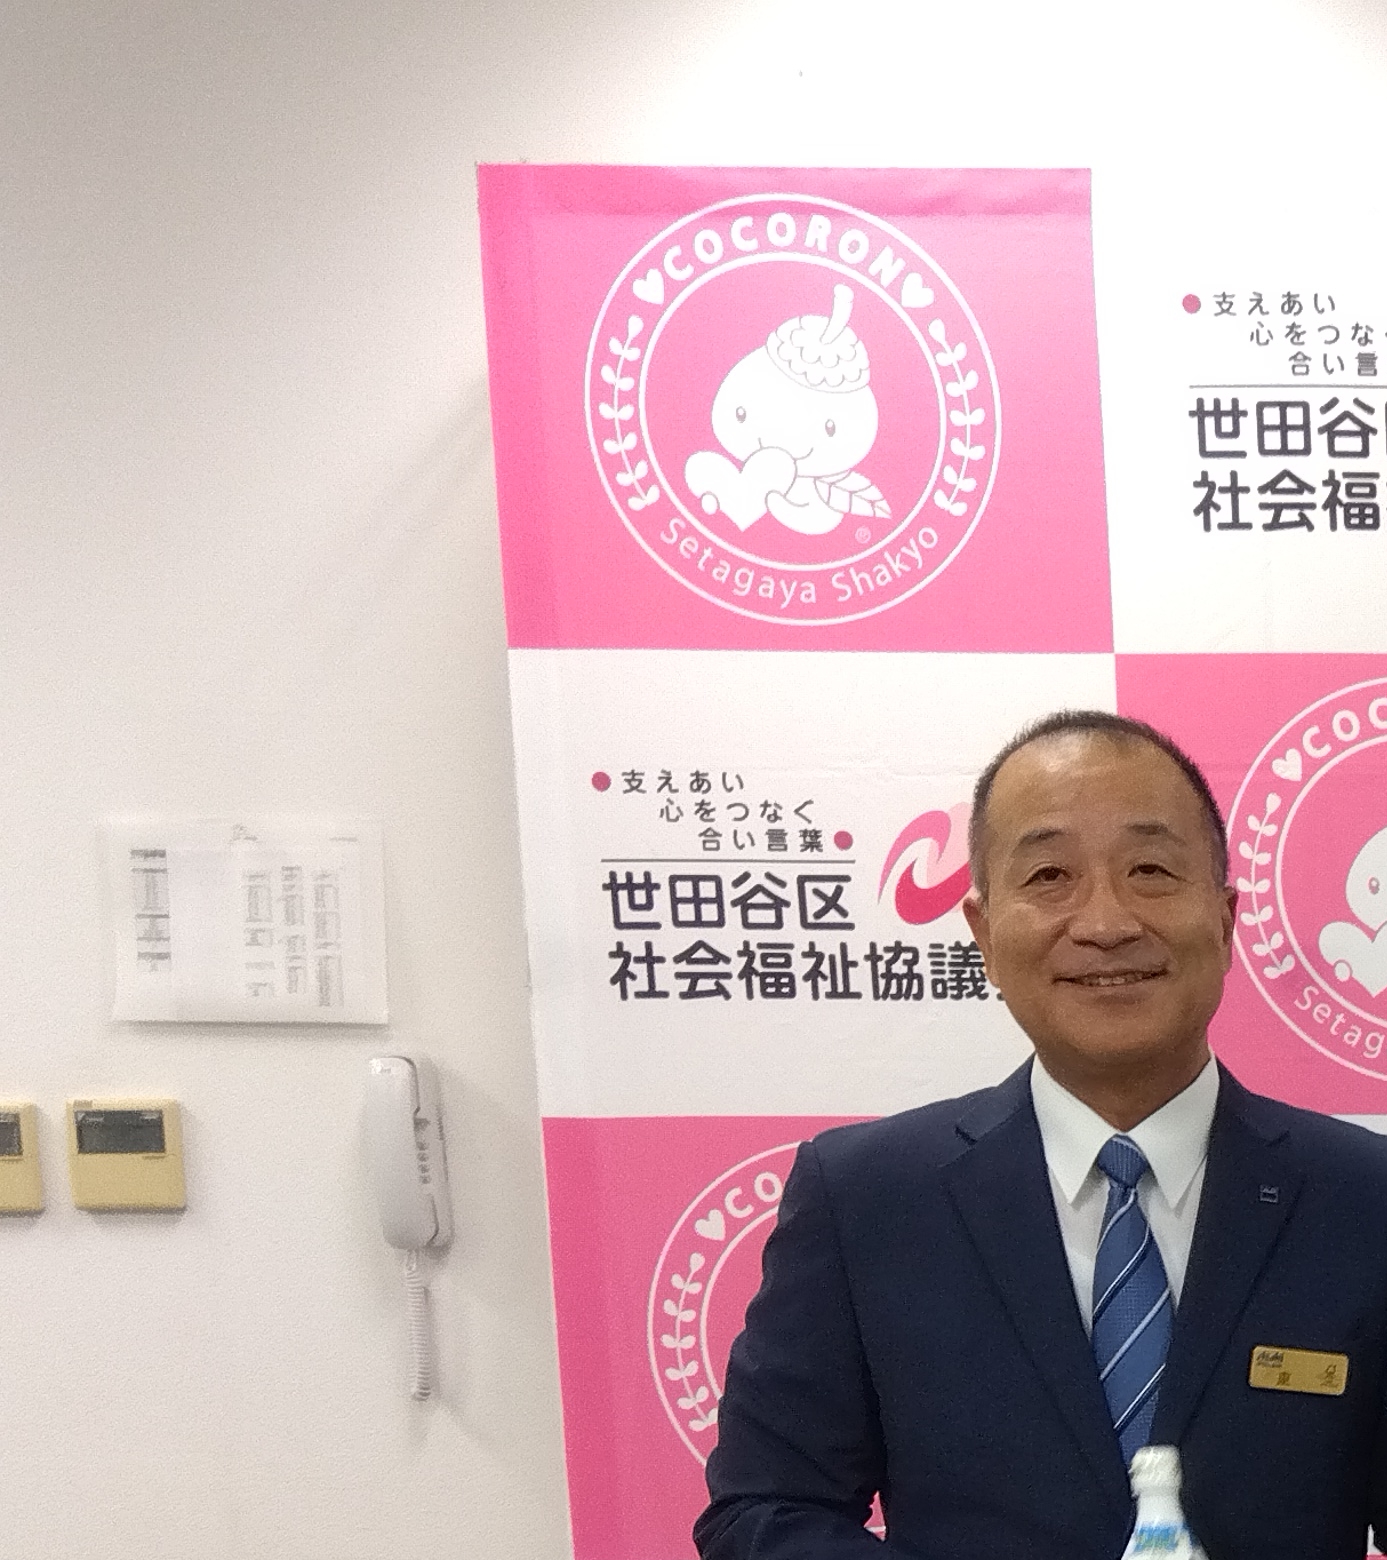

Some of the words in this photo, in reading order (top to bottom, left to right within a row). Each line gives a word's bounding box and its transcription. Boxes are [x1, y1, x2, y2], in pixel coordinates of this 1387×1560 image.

[664, 212, 907, 287] COCORON
[1212, 291, 1336, 317] 支えあい
[659, 516, 818, 608] Setagaya
[832, 523, 940, 603] Shakyo
[620, 768, 745, 795] 支えあい
[658, 798, 815, 825] 心をつなく
[698, 828, 825, 853] 合い言葉
[601, 870, 856, 932] 世田谷区
[607, 940, 1003, 1001] 社会福祉協議
